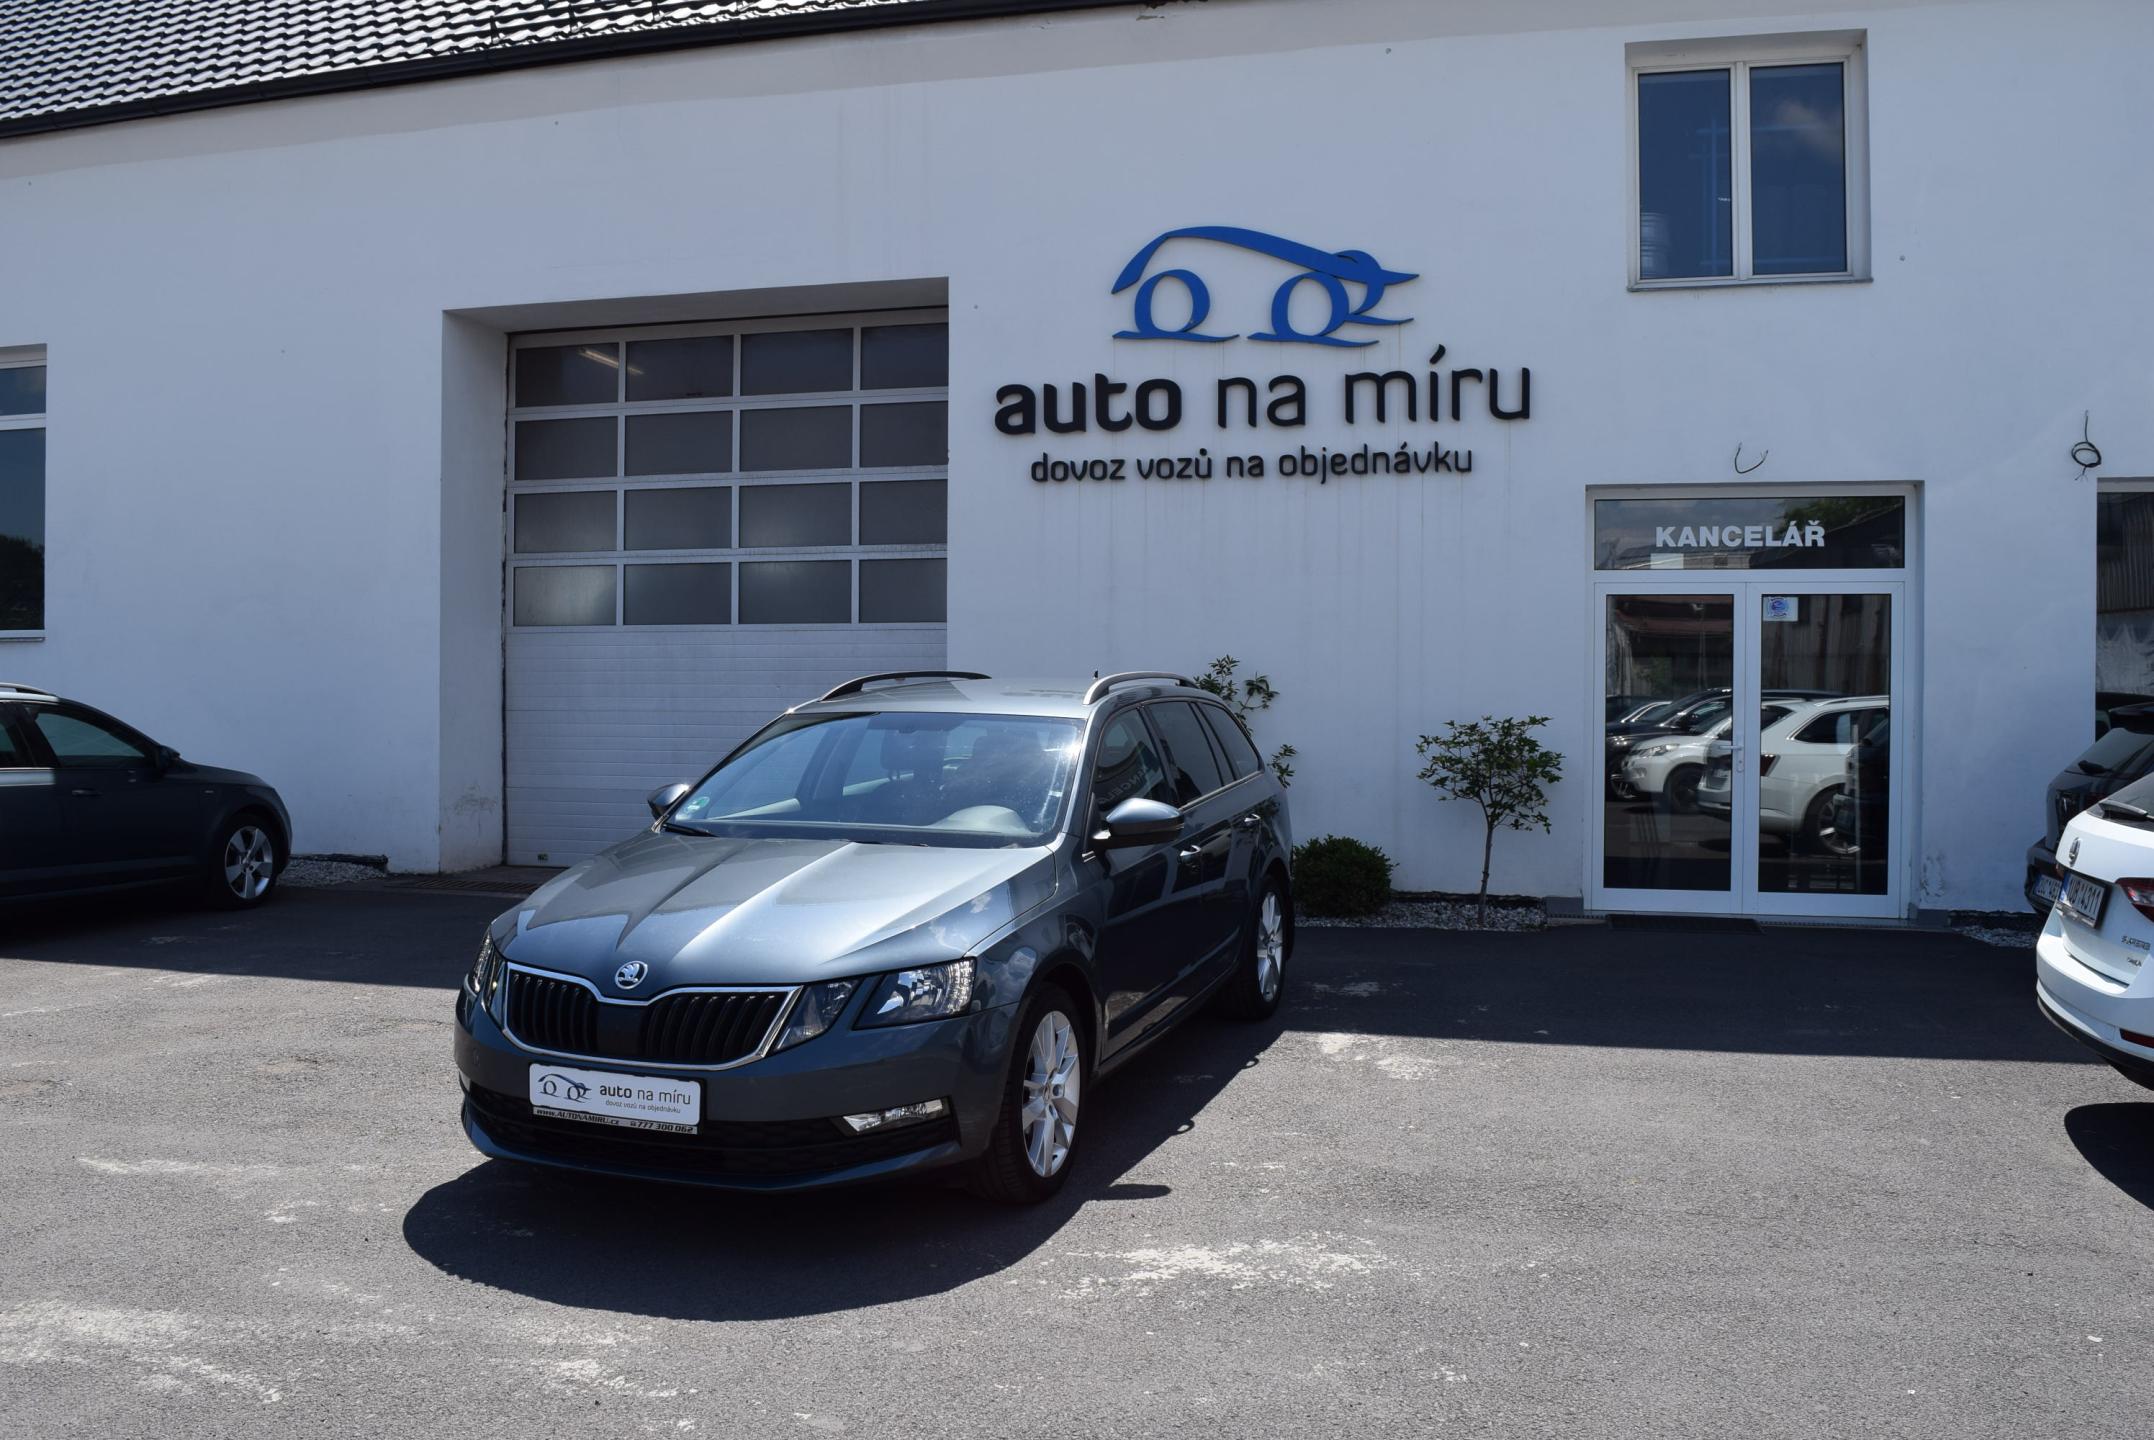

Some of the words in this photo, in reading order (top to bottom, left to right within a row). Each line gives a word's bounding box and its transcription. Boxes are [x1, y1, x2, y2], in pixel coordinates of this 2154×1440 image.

[994, 373, 1183, 435] auto
[1217, 374, 1306, 429] na
[1344, 344, 1531, 425] míru
[1030, 452, 1126, 483] dovoz
[1136, 447, 1213, 480] vozů
[1226, 455, 1265, 479] na
[1278, 441, 1473, 485] objednávku
[1655, 520, 1826, 548] KANCELÁŘ
[600, 1084, 632, 1099] auto
[637, 1089, 654, 1101] na
[659, 1089, 691, 1105] míru
[636, 1120, 654, 1129] 777
